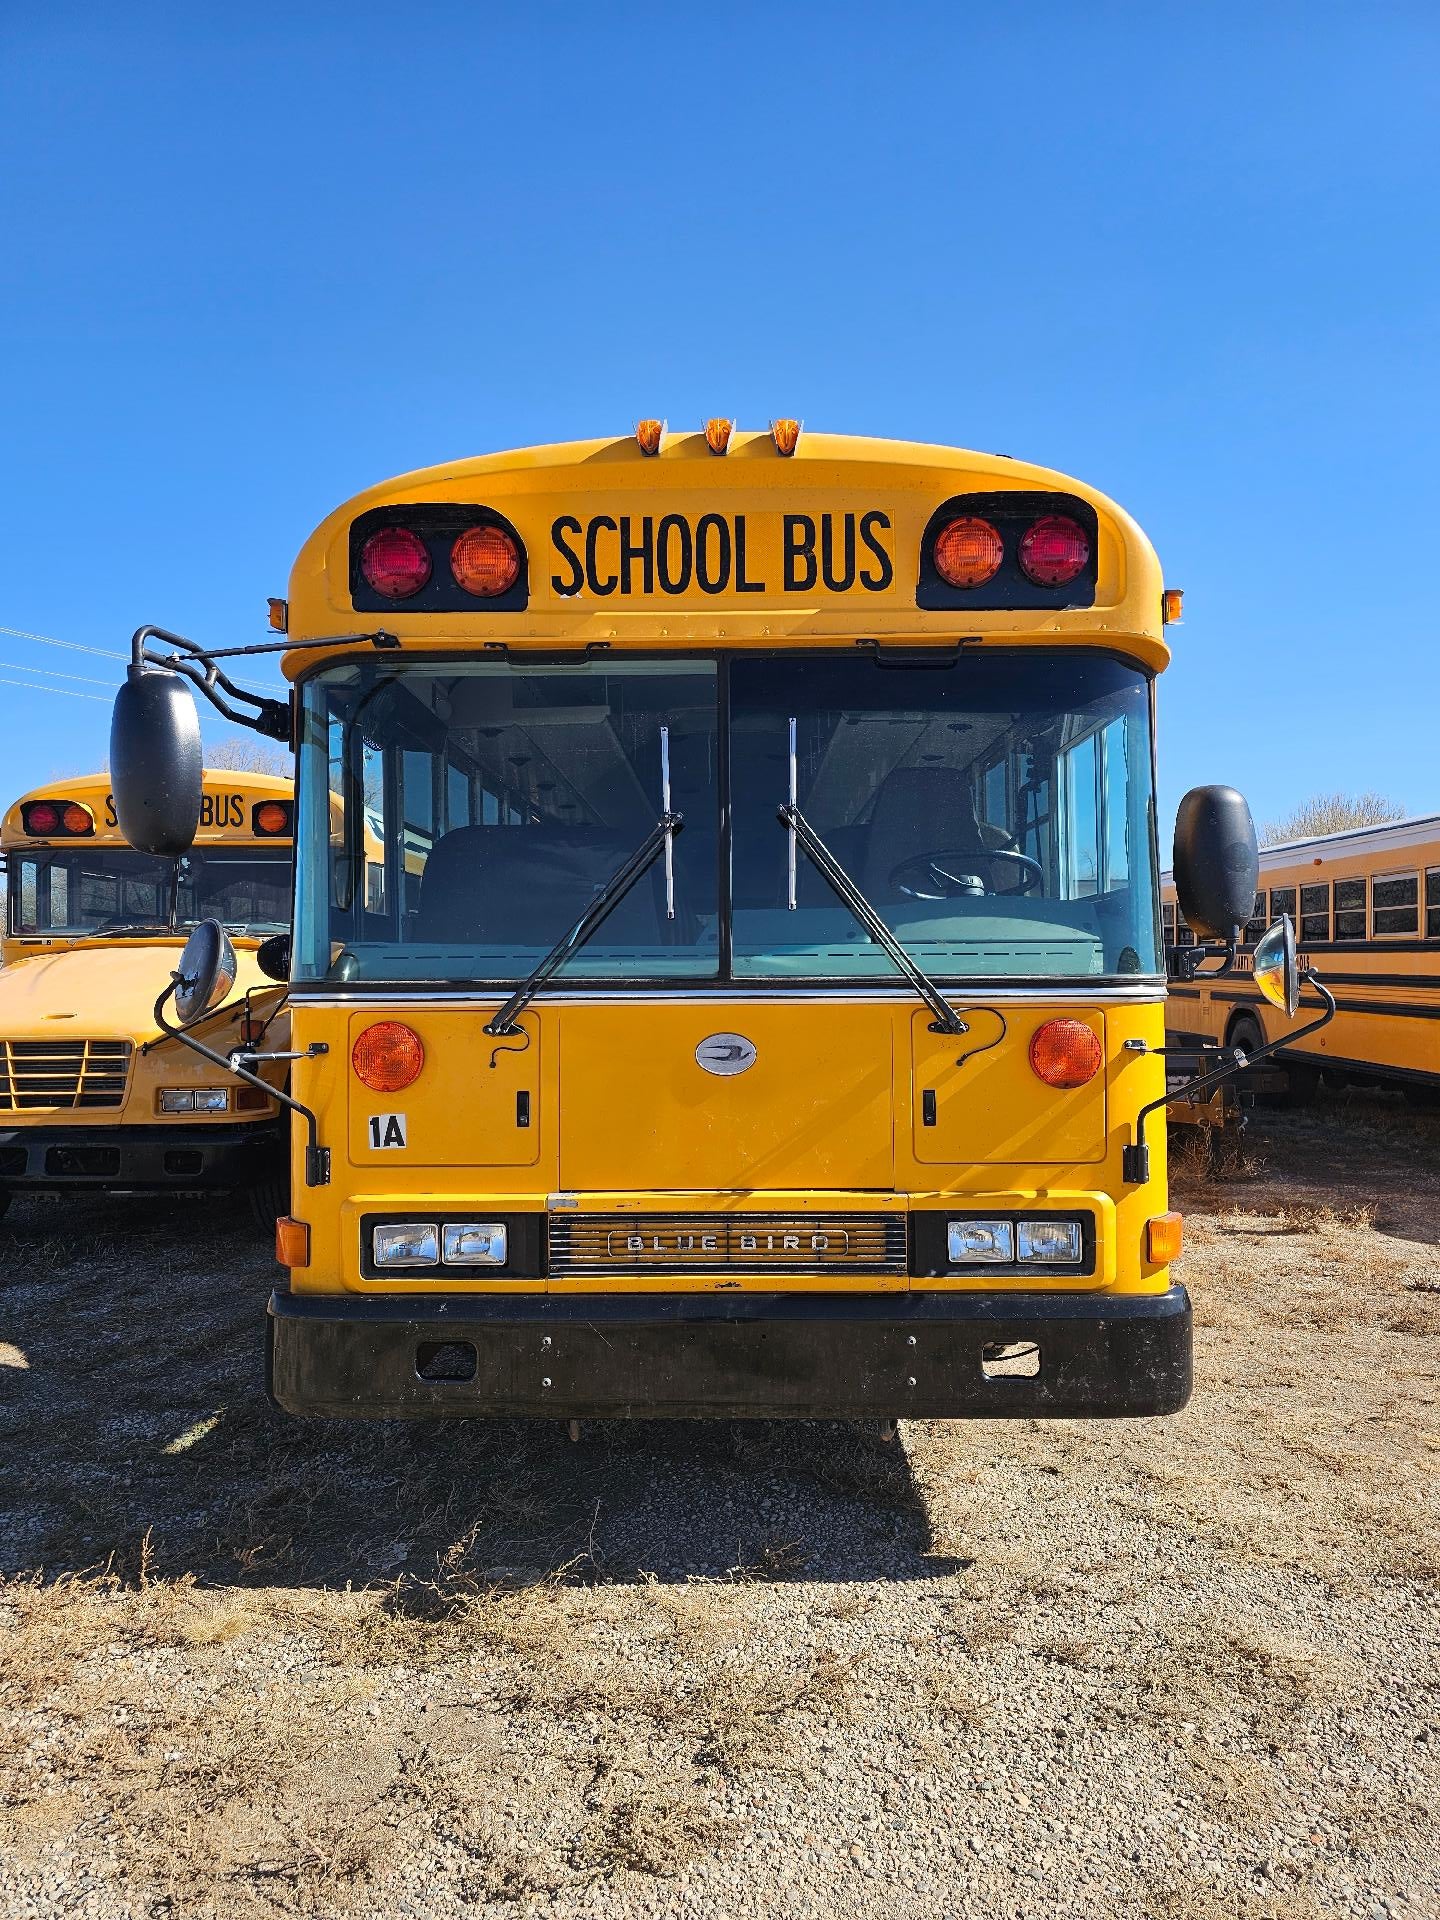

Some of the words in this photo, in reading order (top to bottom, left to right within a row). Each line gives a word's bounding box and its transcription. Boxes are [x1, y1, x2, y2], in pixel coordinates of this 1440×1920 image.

[551, 513, 766, 596] SCHOOL
[783, 511, 893, 592] BUS
[200, 794, 243, 827] BUS
[370, 1115, 405, 1148] 1A
[627, 1235, 718, 1251] BLUE
[740, 1235, 829, 1251] BIRD
